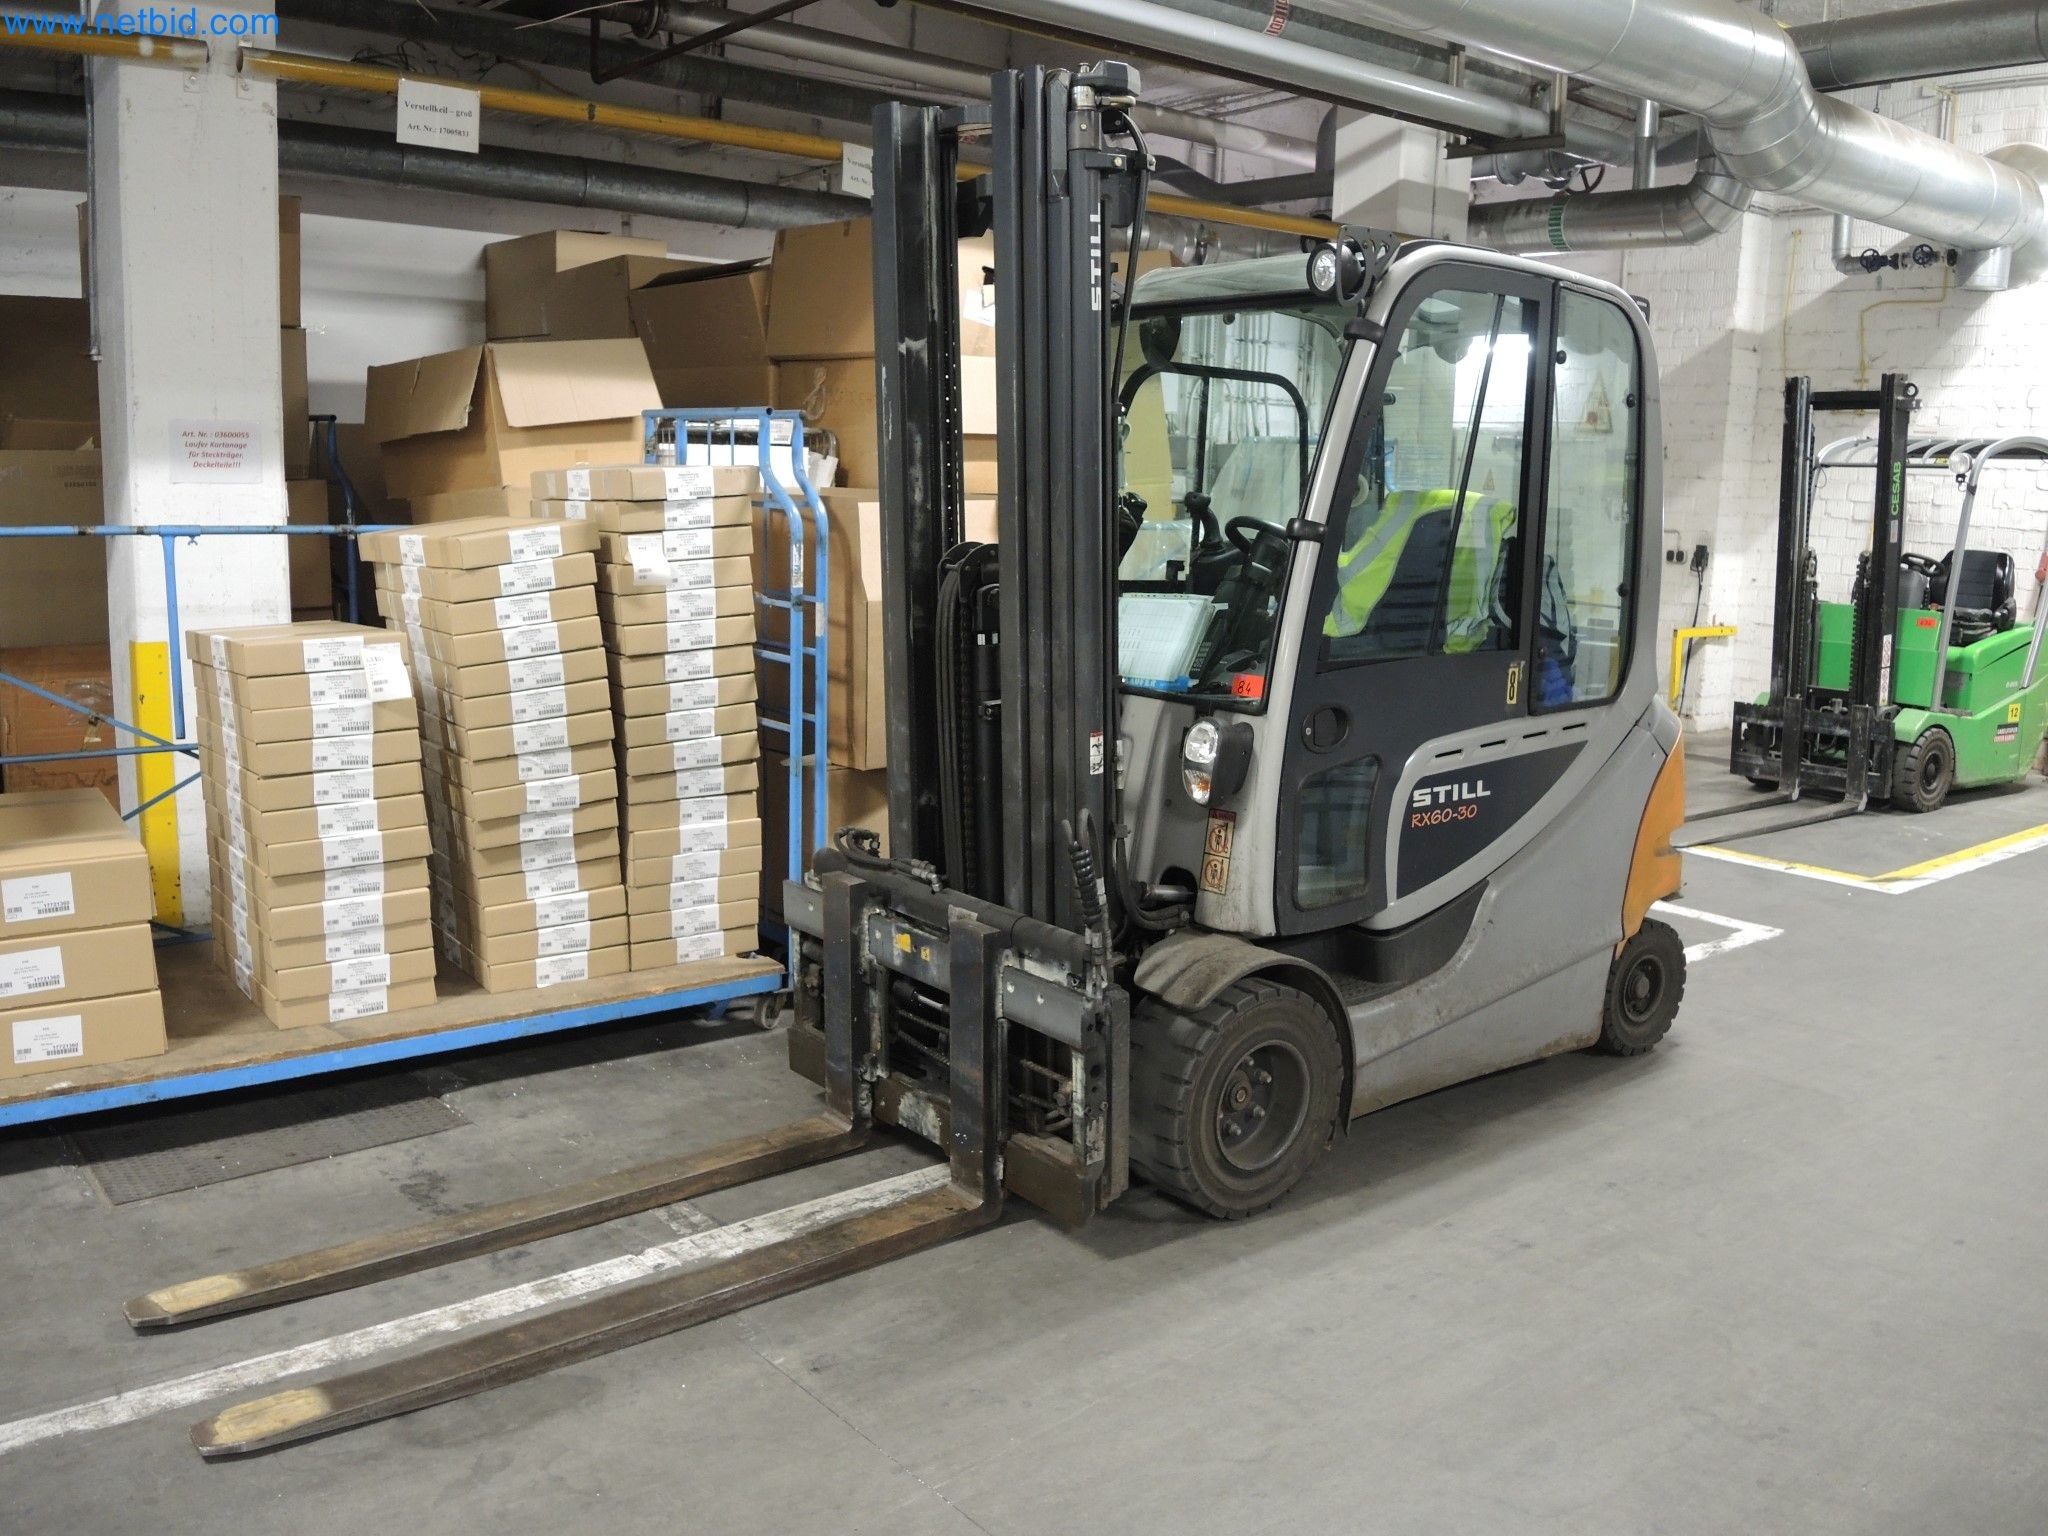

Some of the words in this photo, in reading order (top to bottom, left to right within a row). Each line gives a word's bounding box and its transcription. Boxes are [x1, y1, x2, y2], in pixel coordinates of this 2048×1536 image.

[1089, 202, 1102, 311] STILL
[1891, 461, 1901, 516] CESAB
[1237, 680, 1252, 695] 84
[2010, 707, 2019, 718] 12
[1412, 779, 1491, 808] STILL
[1411, 804, 1478, 828] RX60-30
